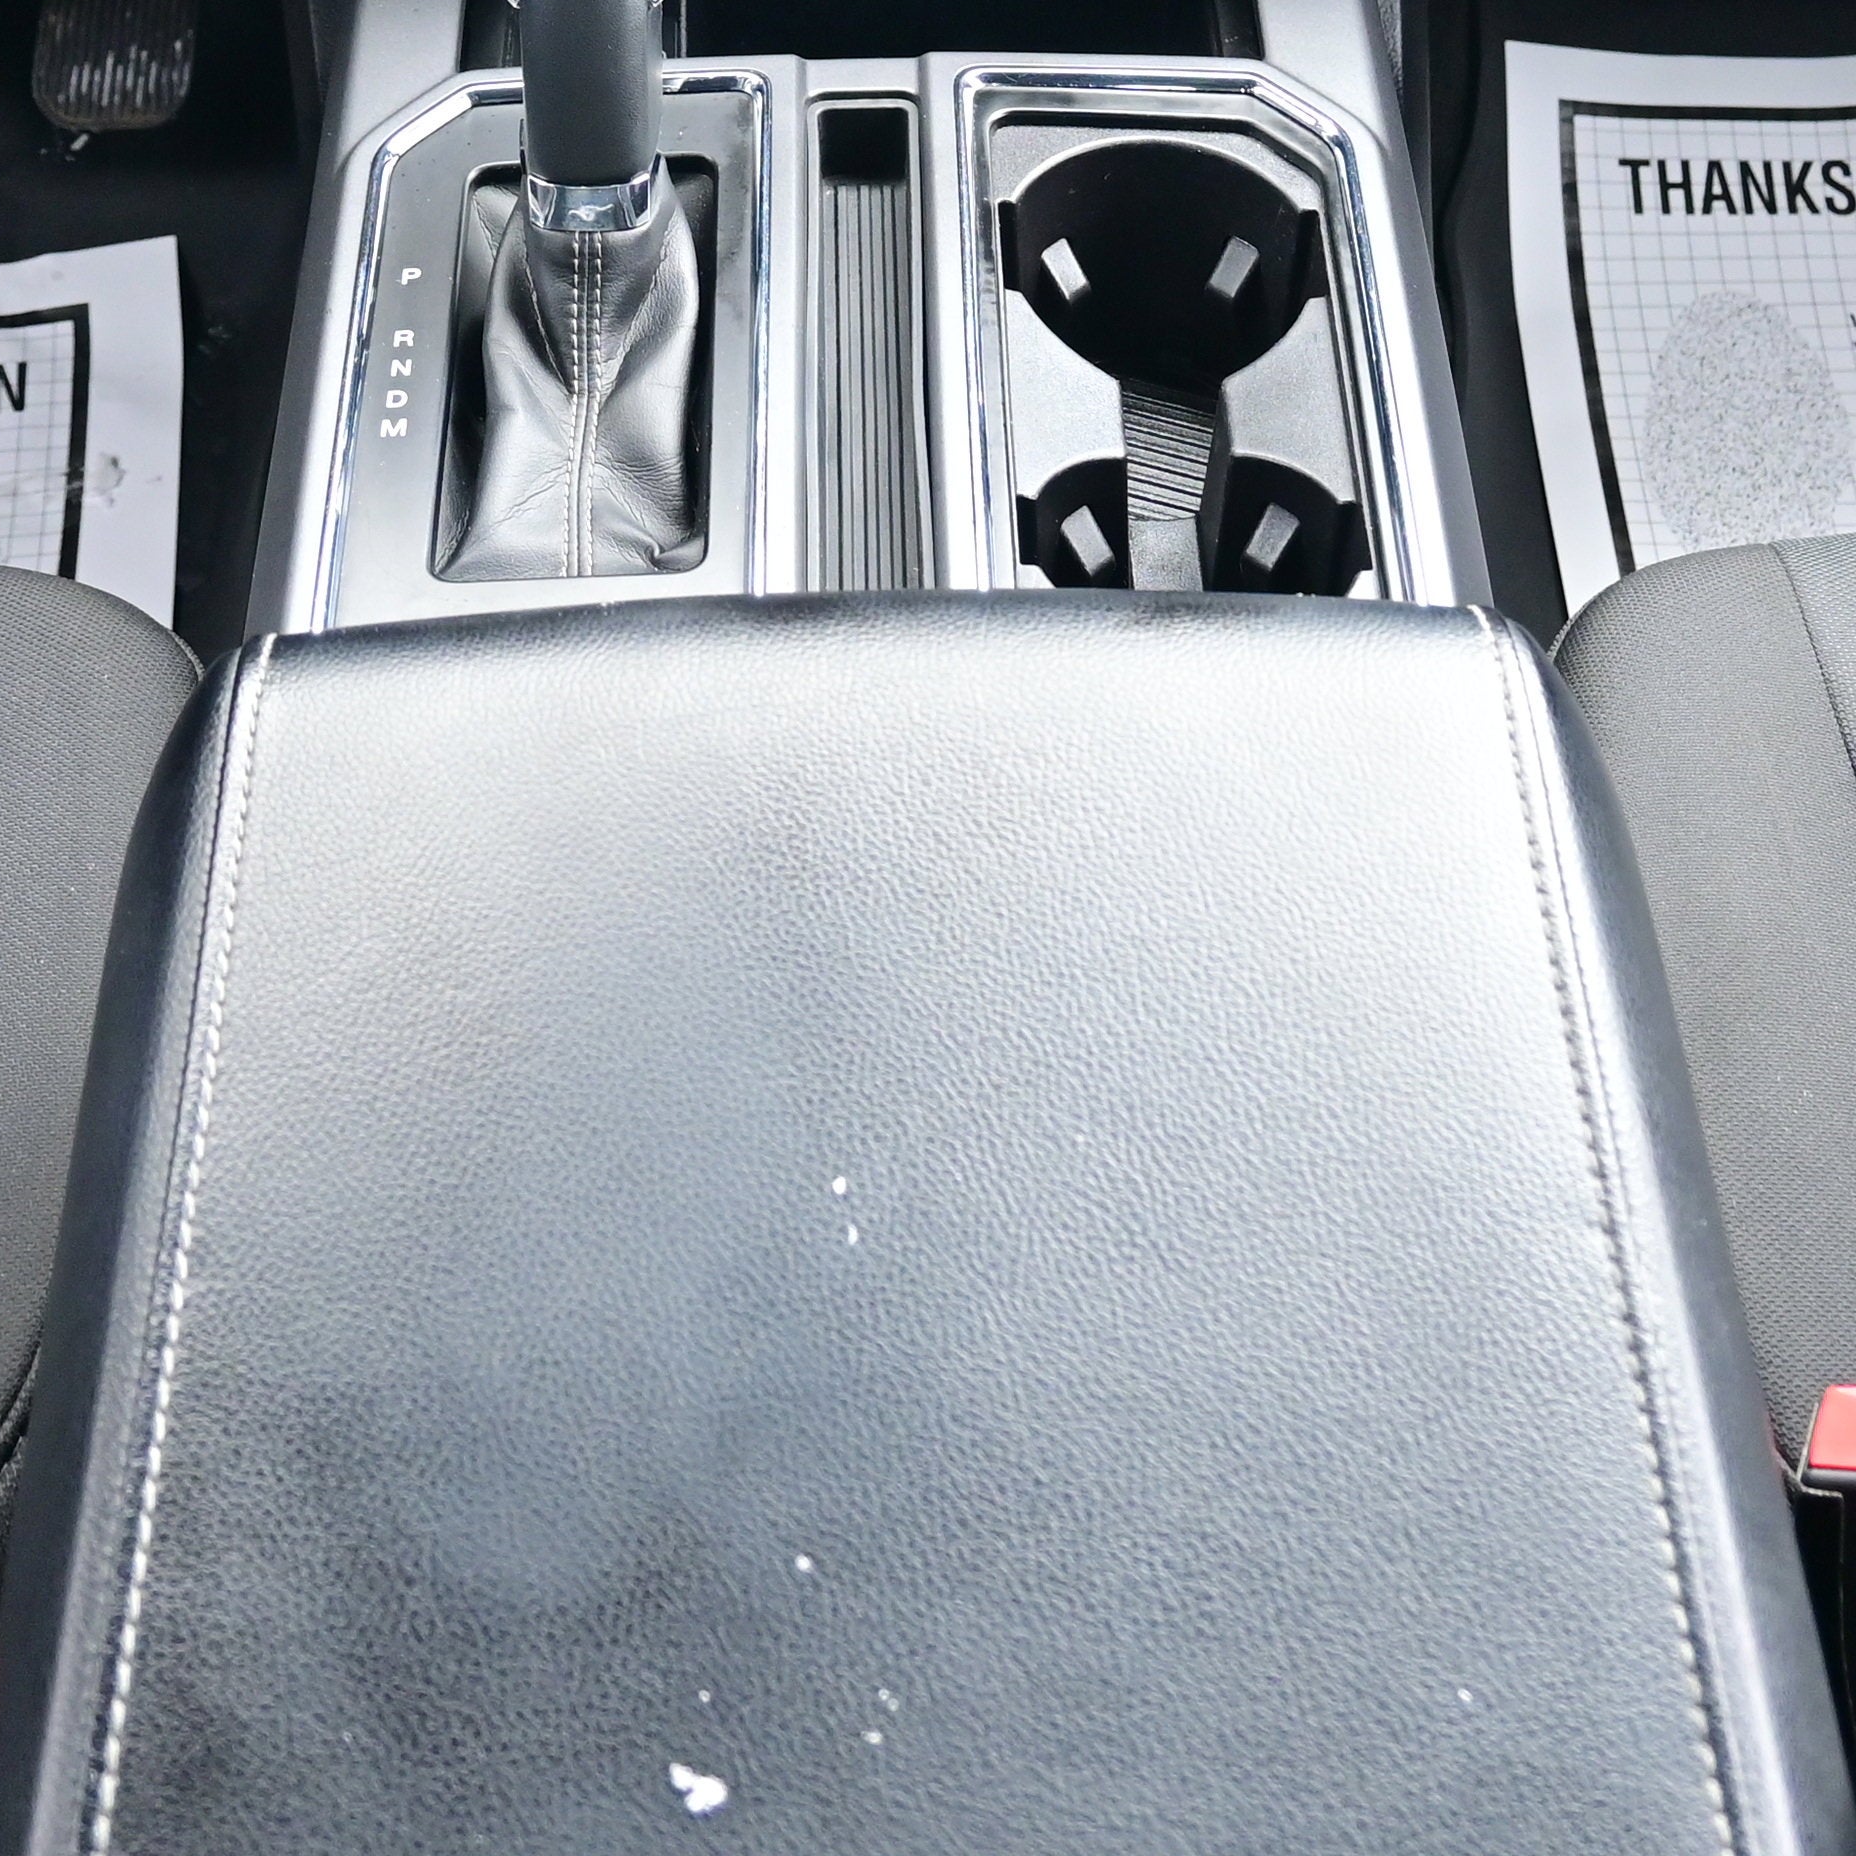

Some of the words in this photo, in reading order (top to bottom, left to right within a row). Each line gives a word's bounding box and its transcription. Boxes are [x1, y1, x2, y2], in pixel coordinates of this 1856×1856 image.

[1619, 156, 1856, 218] THANKS
[401, 268, 422, 285] P
[393, 330, 415, 347] R
[390, 359, 412, 377] N
[385, 391, 409, 408] D
[380, 419, 408, 438] M
